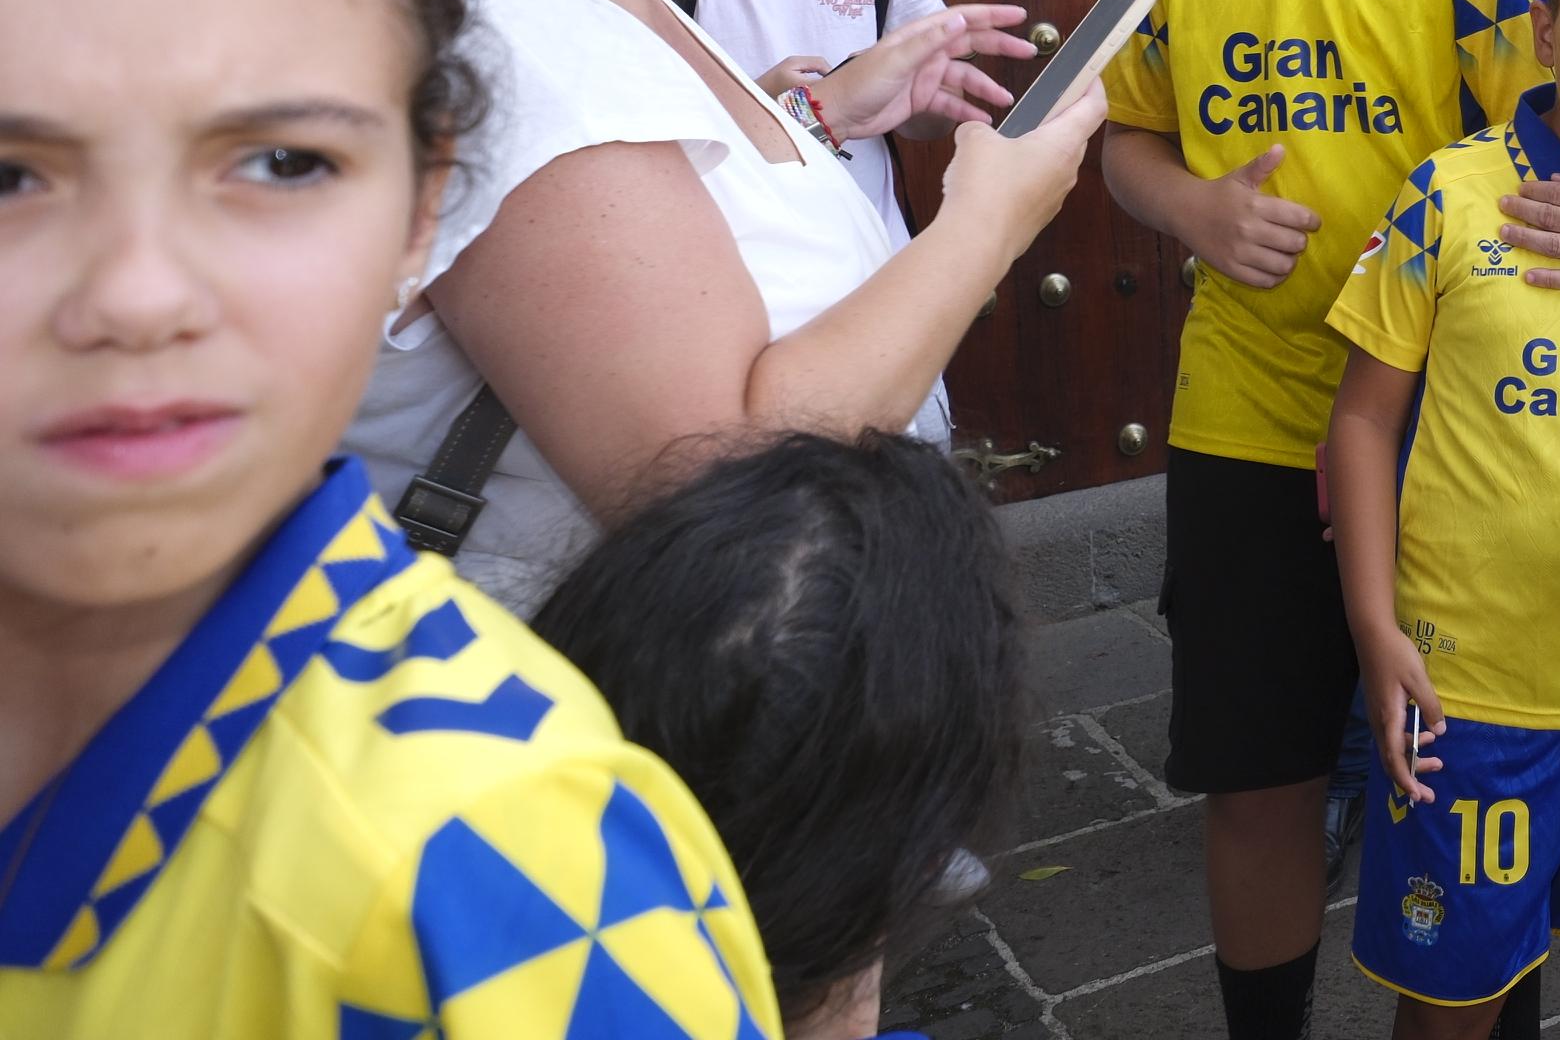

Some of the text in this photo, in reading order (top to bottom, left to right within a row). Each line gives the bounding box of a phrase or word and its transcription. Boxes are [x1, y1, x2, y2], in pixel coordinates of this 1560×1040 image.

[1222, 31, 1343, 82] Gran
[1198, 82, 1404, 135] Canaria
[1471, 265, 1518, 277] hummel
[1416, 619, 1435, 638] UD
[1416, 638, 1433, 655] 75
[1438, 638, 1456, 652] 2024
[1449, 798, 1530, 885] 10
